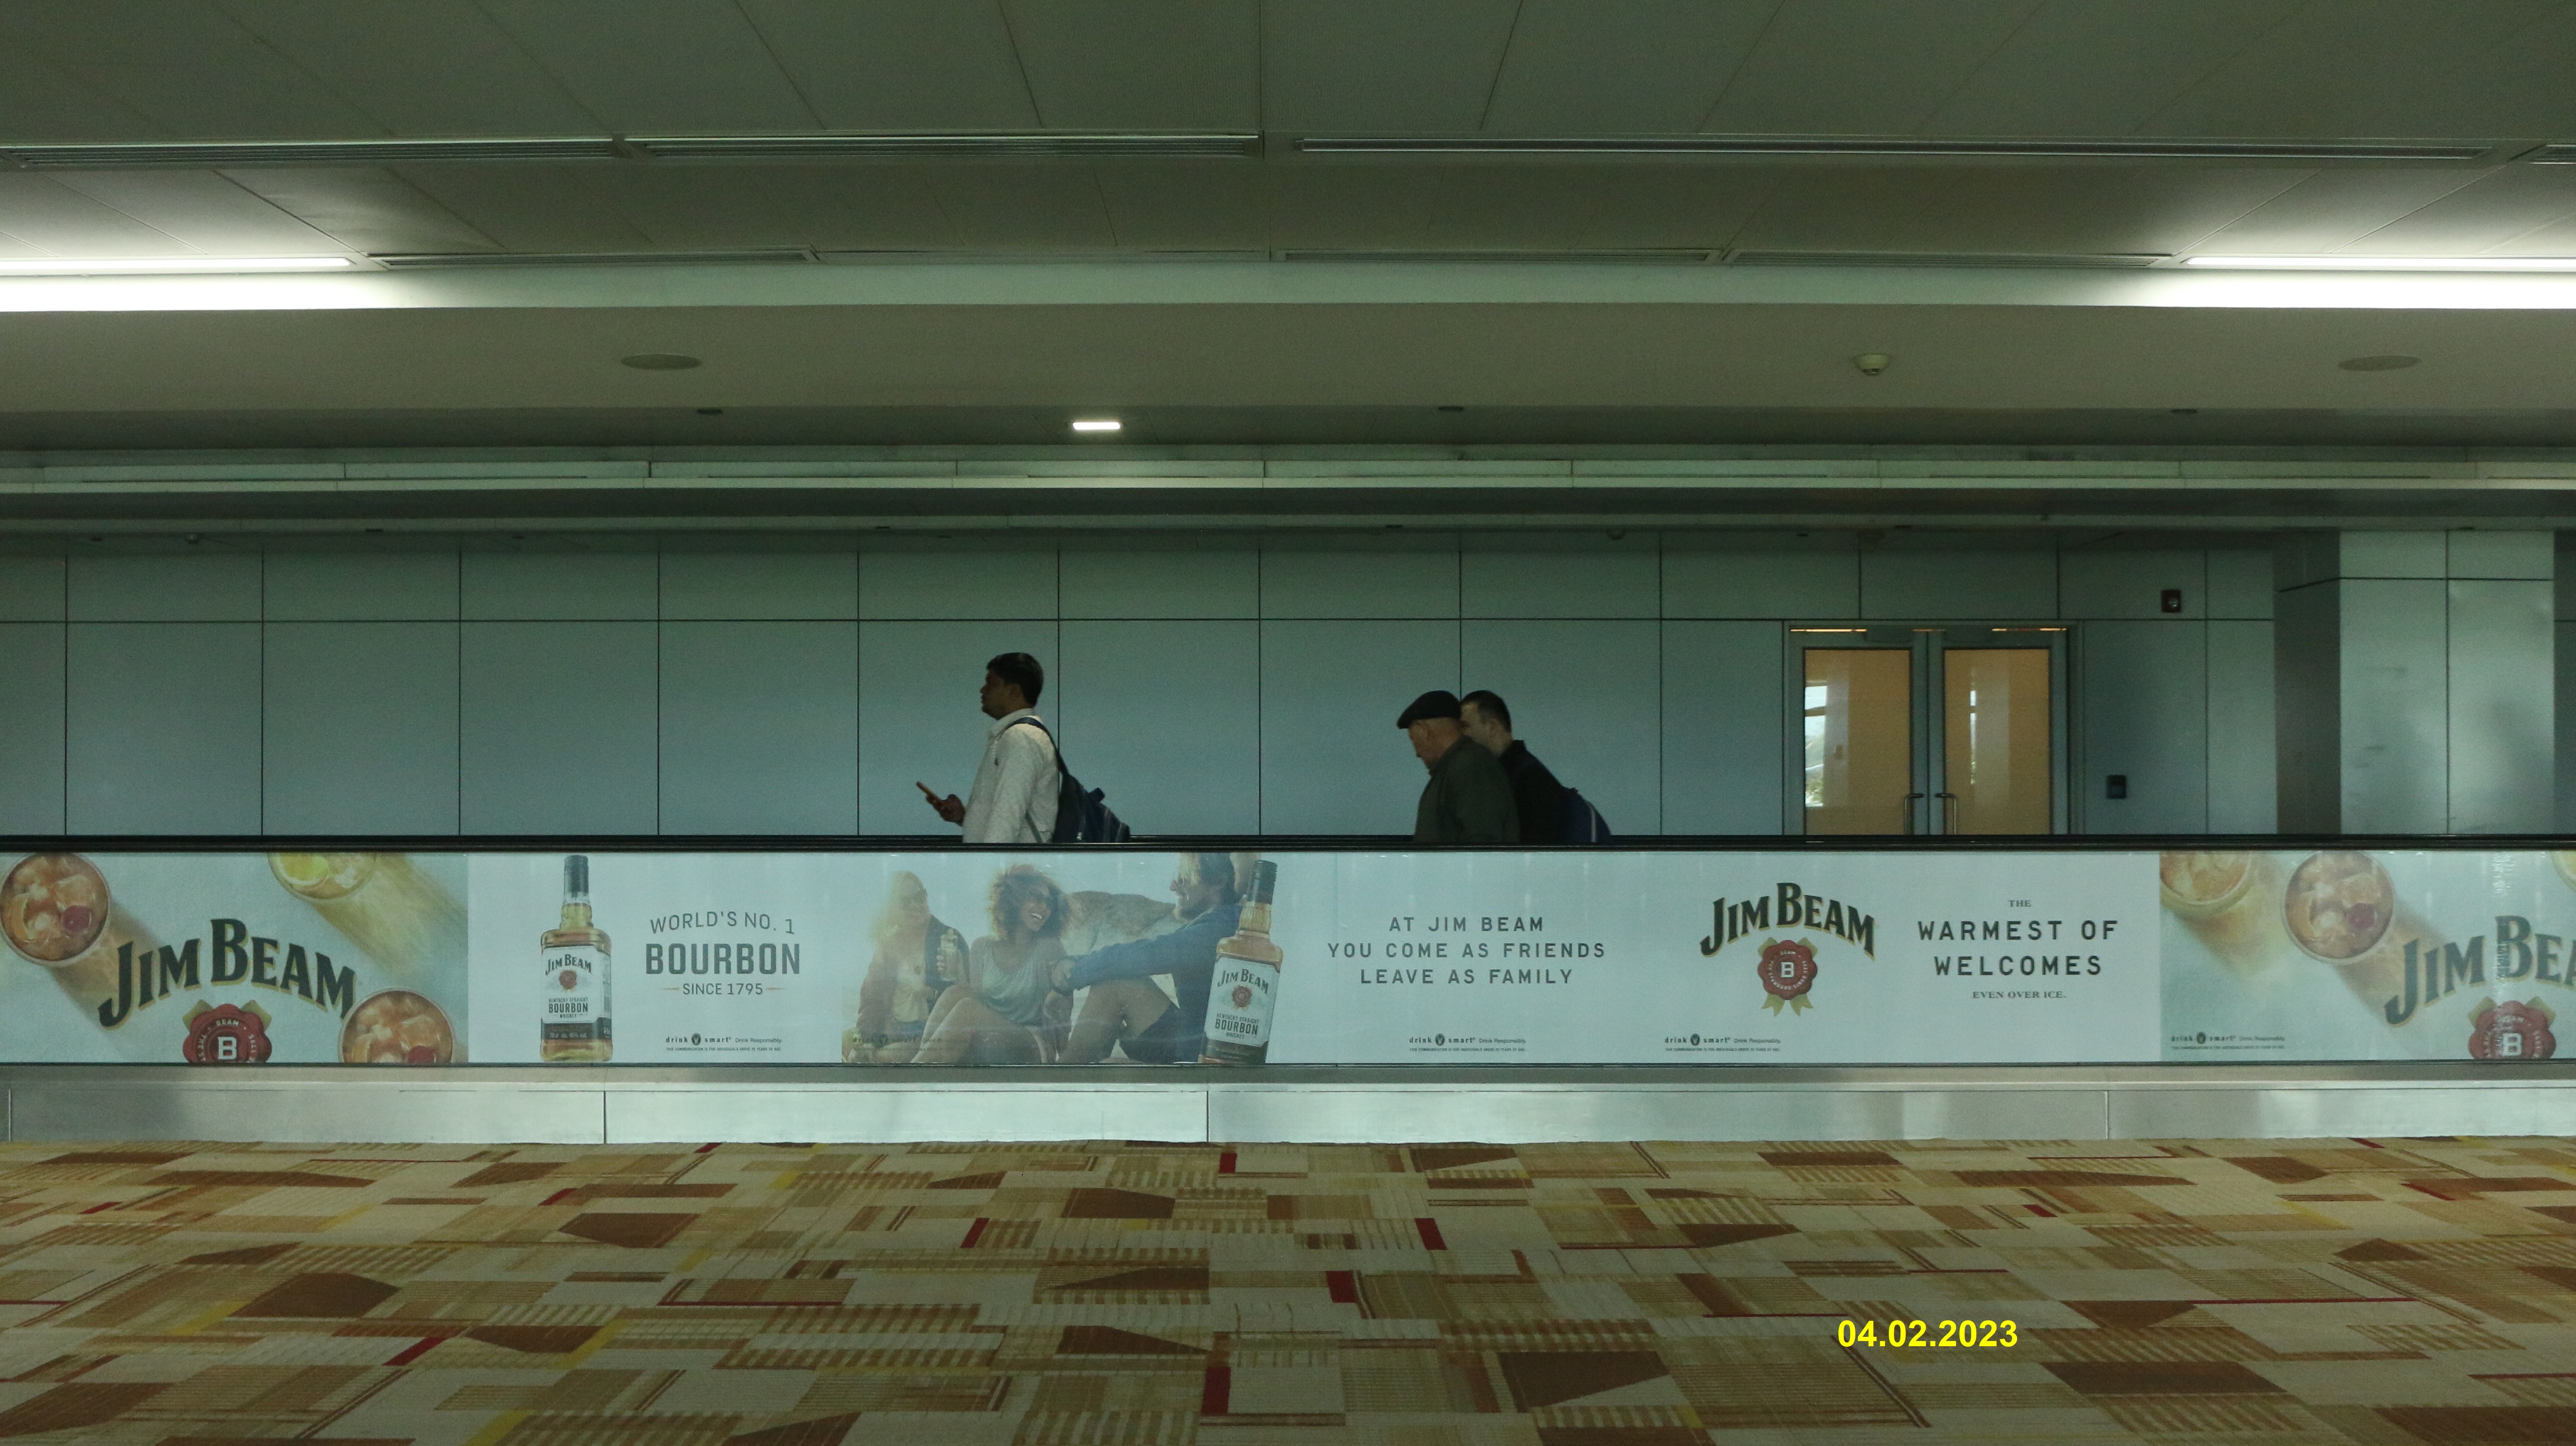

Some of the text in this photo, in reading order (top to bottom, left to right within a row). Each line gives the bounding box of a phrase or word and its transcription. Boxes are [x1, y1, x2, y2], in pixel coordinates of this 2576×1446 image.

[650, 911, 794, 934] WORLD'S NO. 1
[1389, 916, 1543, 932] AT JIM BEAM
[1700, 883, 1875, 960] JIM BEAM
[1918, 920, 2118, 940] WARMEST OF
[646, 943, 800, 975] BOURBON
[1328, 943, 1605, 958] YOU COME AS FRIENDS
[98, 918, 356, 1029] JIM BEAM
[546, 954, 592, 975] JIM BEAM
[1780, 962, 1794, 978] B
[1934, 956, 2102, 976] WELCOMES
[1217, 969, 1269, 995] JIM BEAM
[1361, 969, 1572, 984] LEAVE AS FAMILY
[2384, 935, 2486, 1026] JIM
[683, 983, 763, 995] SINCE 1795
[549, 1003, 588, 1013] BOURBON
[216, 1019, 240, 1027] BEAM
[1215, 1019, 1258, 1035] BOURBON
[217, 1036, 237, 1060] B
[2502, 1033, 2522, 1056] B
